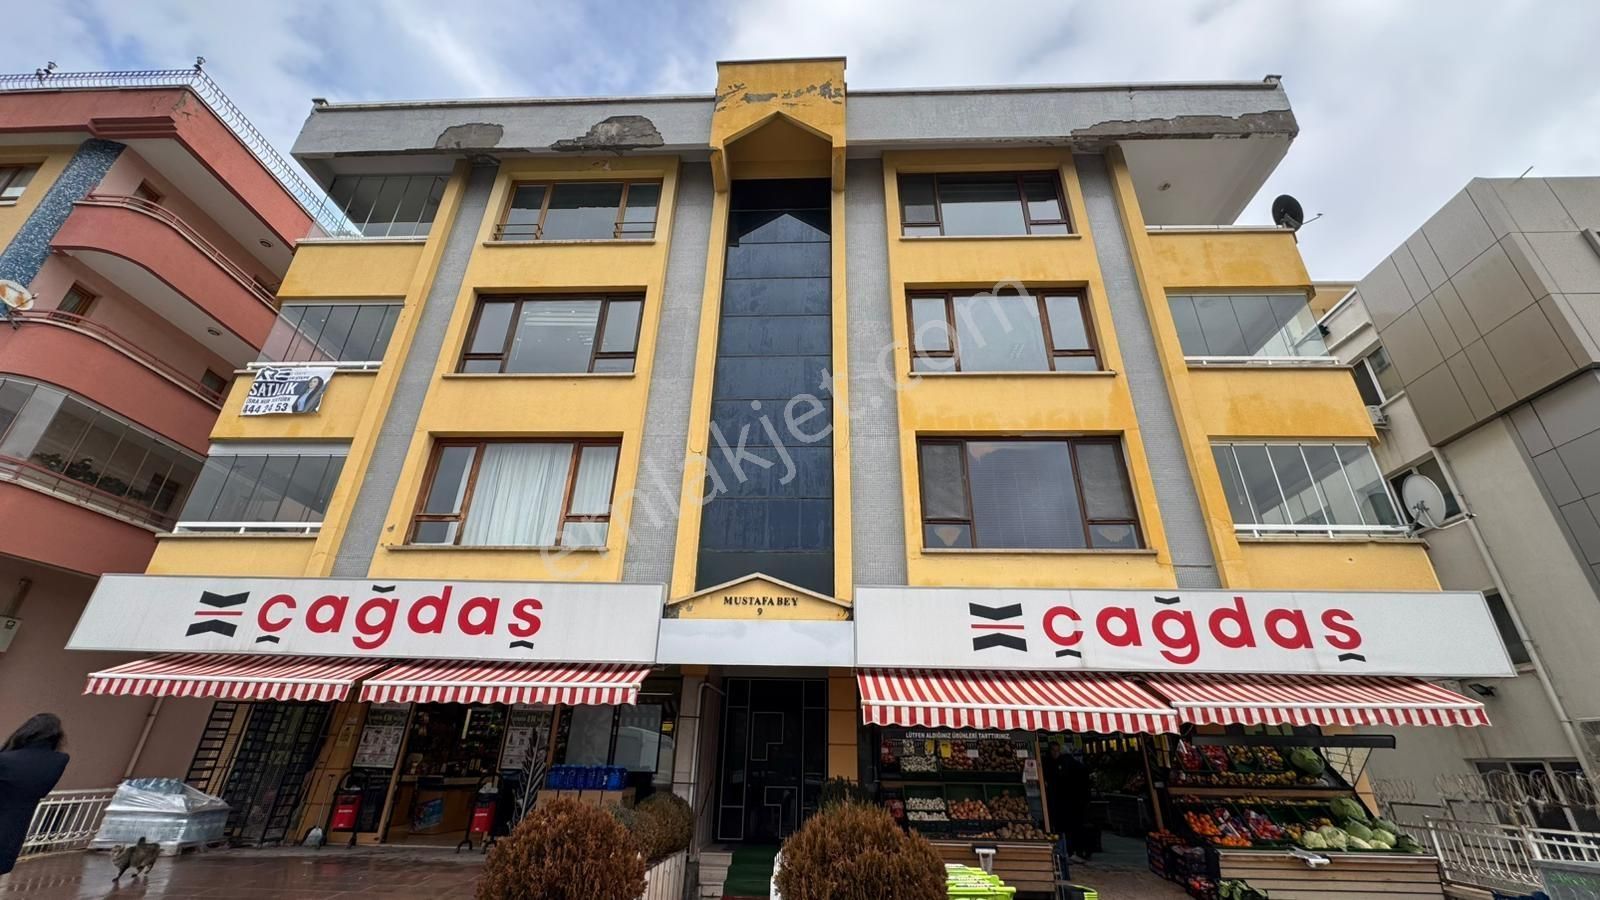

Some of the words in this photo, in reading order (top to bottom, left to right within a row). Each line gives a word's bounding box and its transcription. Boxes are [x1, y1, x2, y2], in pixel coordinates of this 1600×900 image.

[250, 383, 298, 397] SATILIK
[275, 402, 288, 411] 53
[255, 584, 543, 650] çağdaş
[757, 607, 763, 616] 9
[1042, 595, 1366, 664] çağdaş
[905, 731, 925, 739] LÜTFEN
